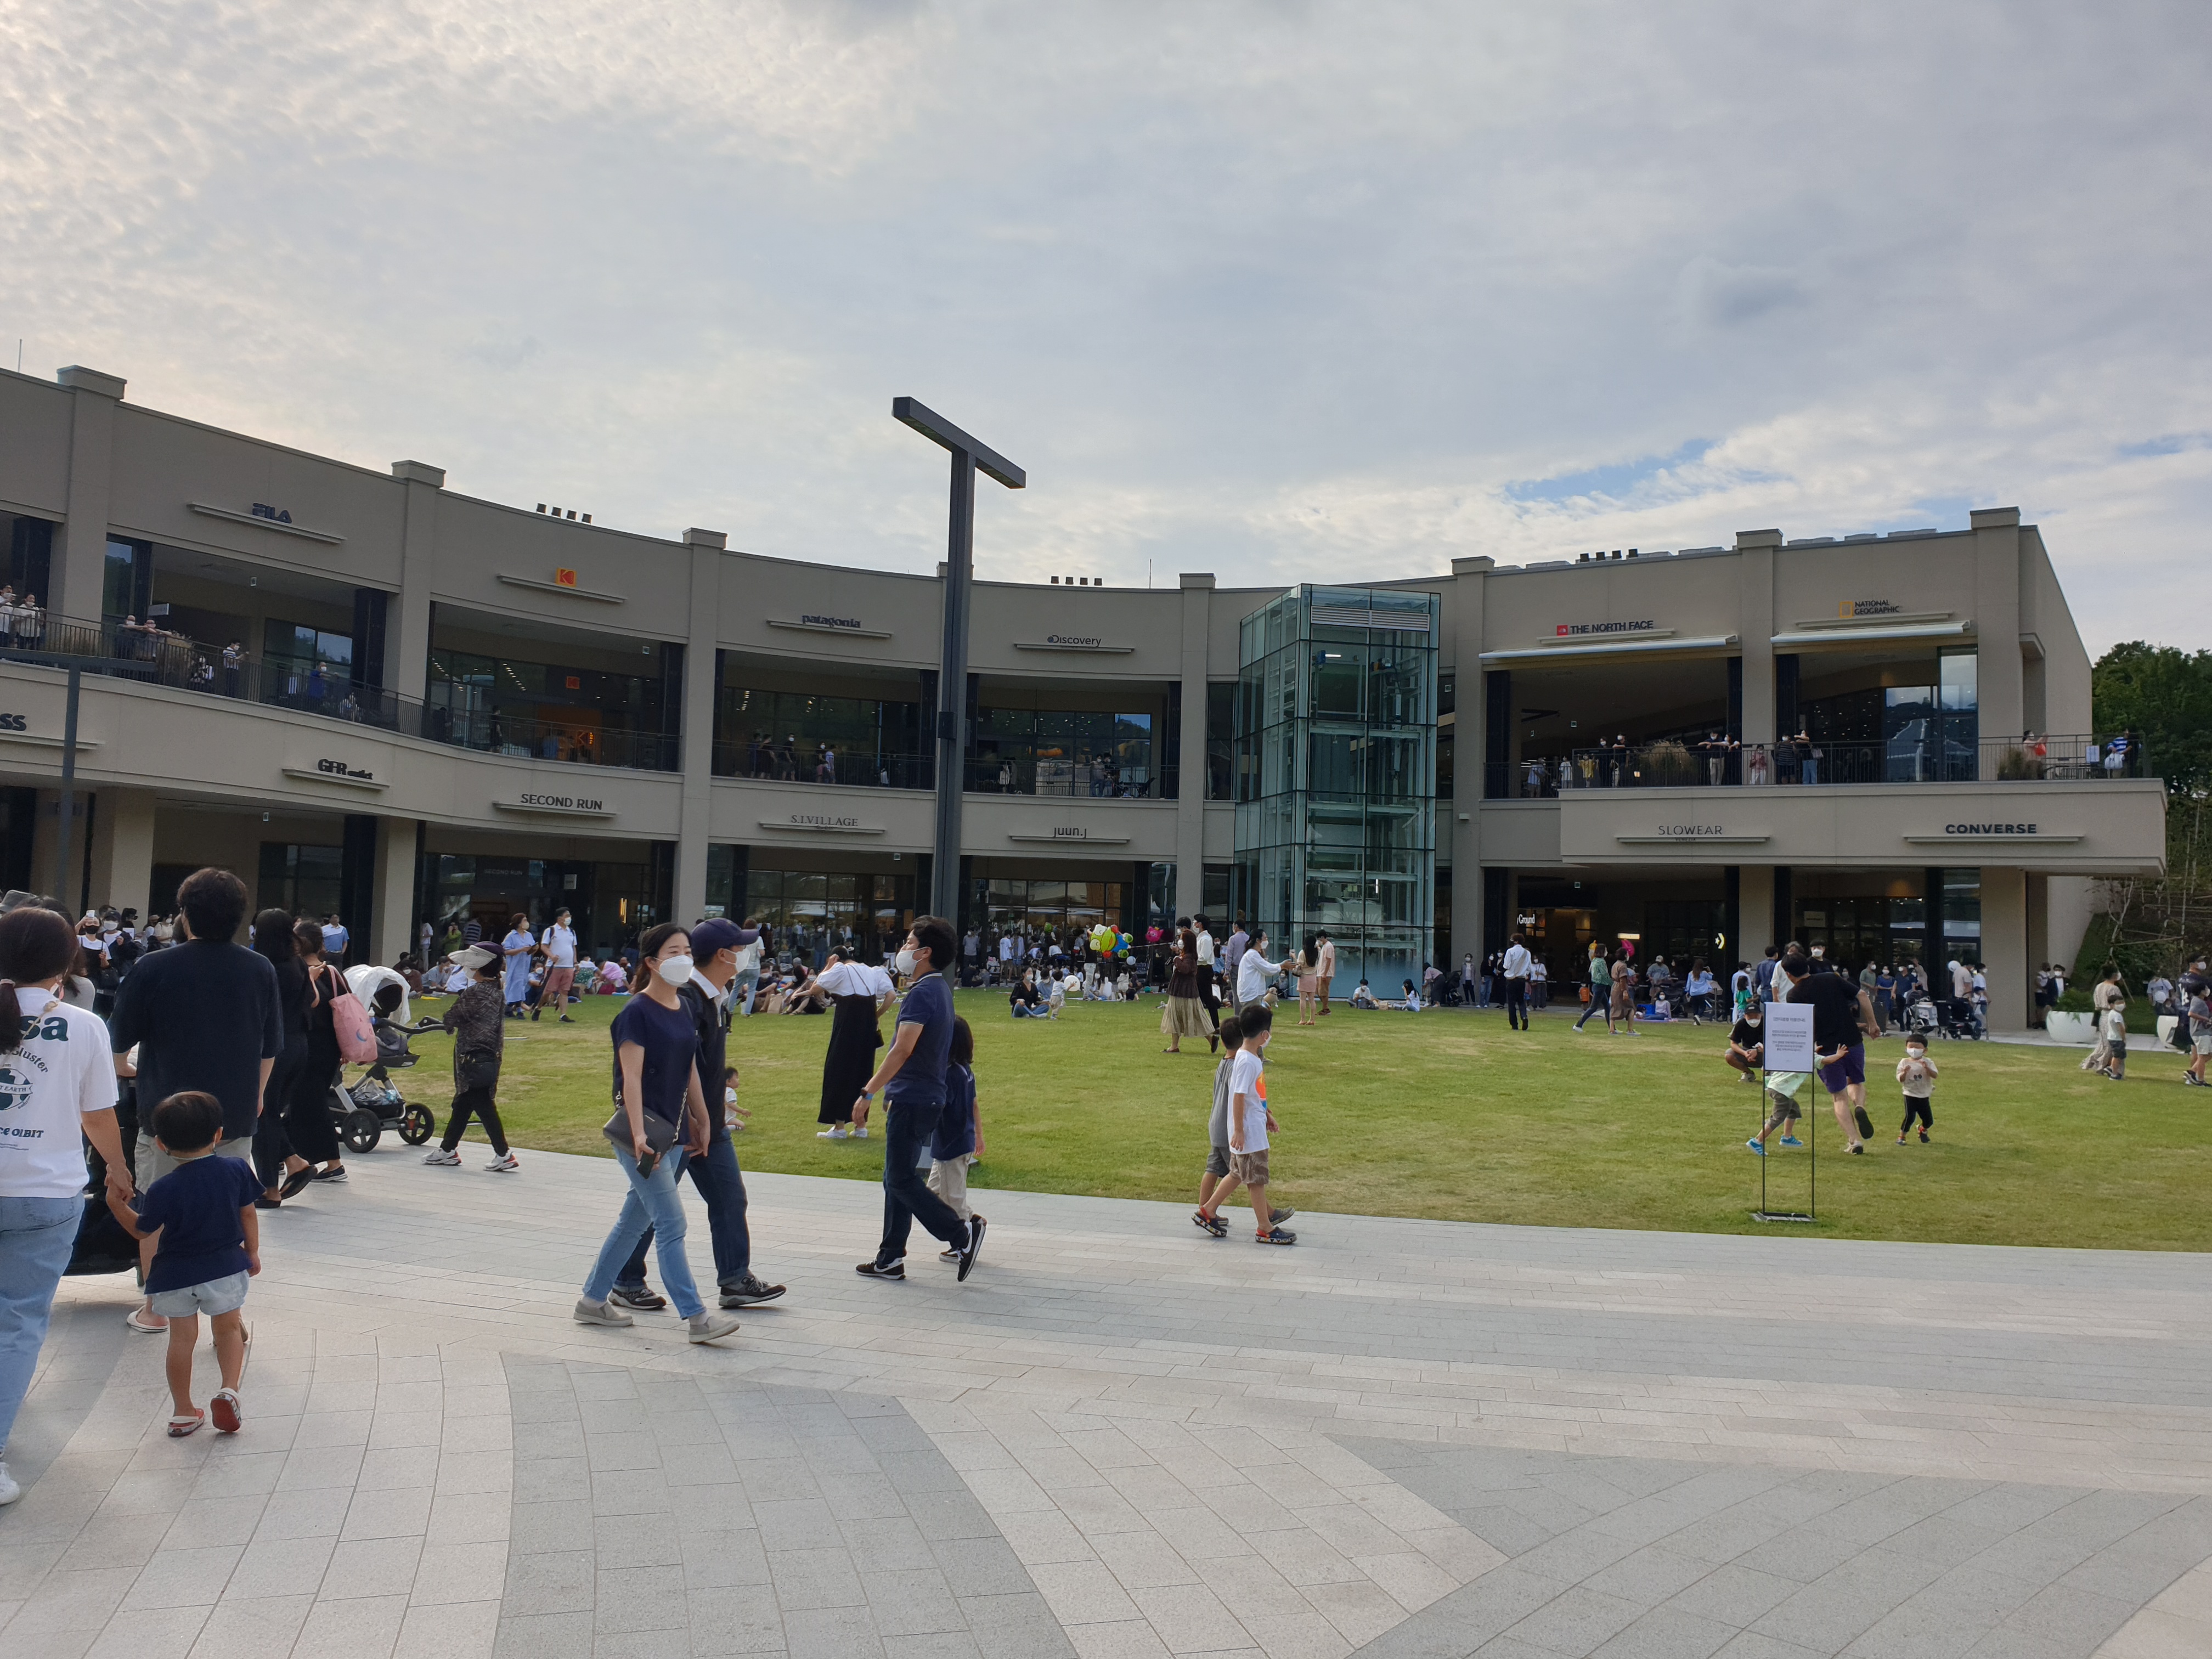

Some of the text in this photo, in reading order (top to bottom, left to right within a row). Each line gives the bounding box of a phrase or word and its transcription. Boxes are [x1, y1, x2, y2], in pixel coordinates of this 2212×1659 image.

[252, 503, 292, 523] FILA
[1854, 606, 1900, 615] GEOGRAPHIC
[802, 615, 861, 628] patagonia
[1570, 620, 1654, 633] THE NORTH FACE
[1052, 635, 1102, 647] Discovery
[318, 759, 348, 775] GFR
[521, 794, 602, 810] SECOND RUN
[791, 815, 858, 827] S.I.VILLAGE
[1658, 825, 1722, 834] SLOWEAR
[1945, 824, 2037, 834] CONVERSE
